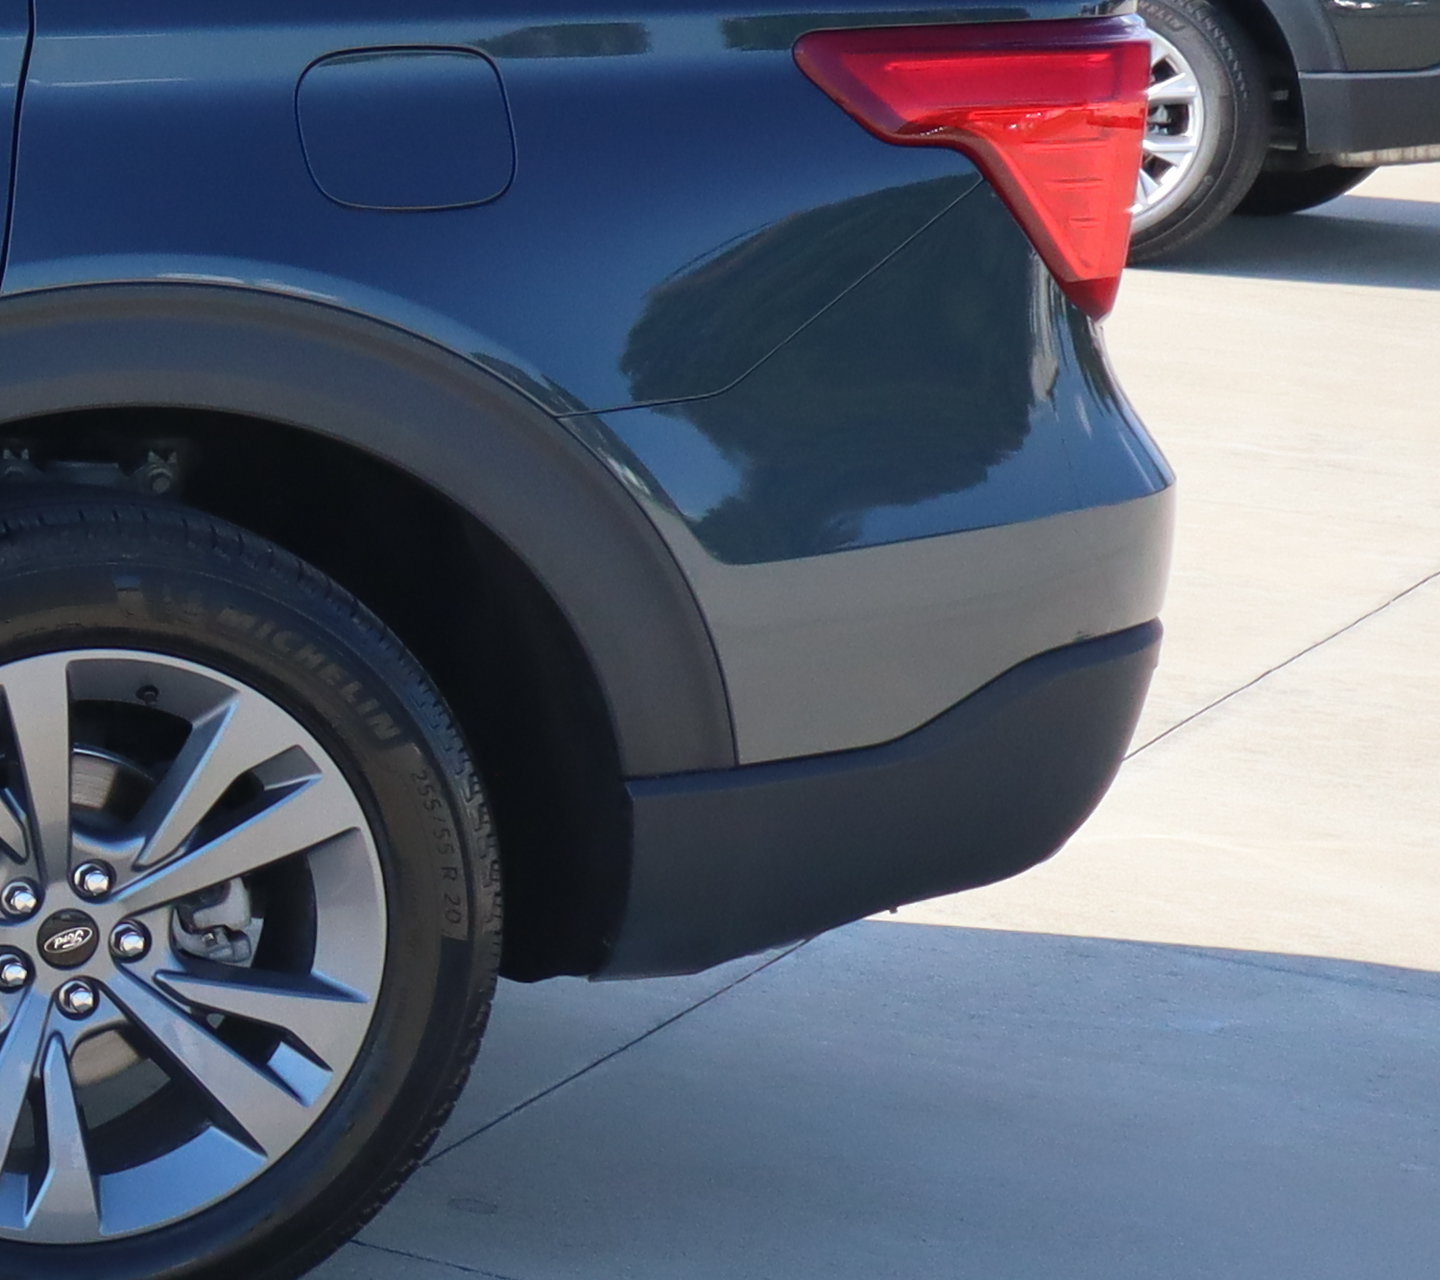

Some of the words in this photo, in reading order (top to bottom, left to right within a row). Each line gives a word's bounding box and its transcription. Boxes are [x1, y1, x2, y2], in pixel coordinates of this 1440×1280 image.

[215, 606, 402, 742] MICHELIN
[413, 772, 457, 858] 255/55
[441, 866, 459, 884] R
[442, 891, 463, 926] 20
